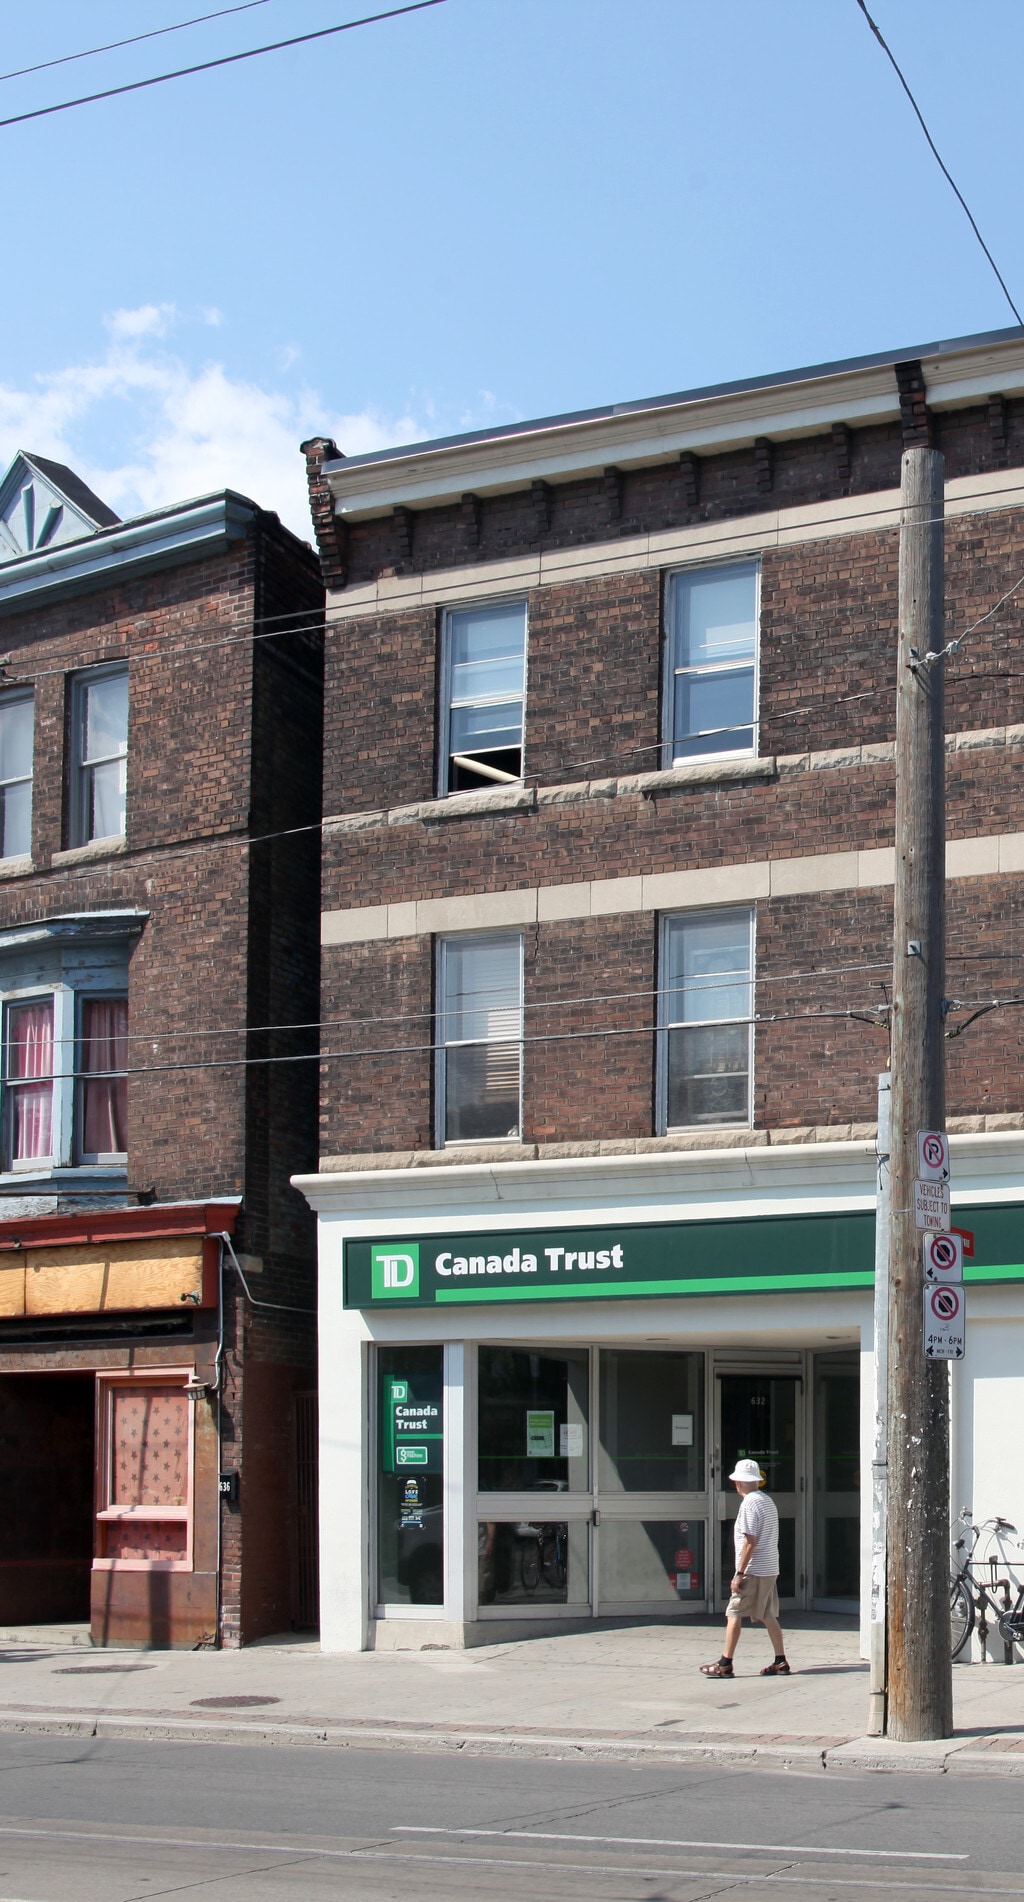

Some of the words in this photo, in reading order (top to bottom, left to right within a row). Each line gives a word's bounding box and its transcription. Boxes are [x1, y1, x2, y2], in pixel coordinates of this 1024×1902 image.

[919, 1184, 944, 1199] VEHICLES
[916, 1198, 939, 1213] SUBJECT
[940, 1201, 948, 1214] TO
[923, 1214, 942, 1229] TOWING
[435, 1248, 537, 1276] Canada
[544, 1244, 624, 1271] Trust
[376, 1254, 414, 1288] TD
[928, 1334, 943, 1344] 4PM
[948, 1335, 962, 1345] 6PM
[391, 1385, 405, 1399] TD
[751, 1397, 766, 1405] 632
[395, 1405, 438, 1417] Canada
[396, 1419, 428, 1430] Trust
[219, 1481, 231, 1492] 636
